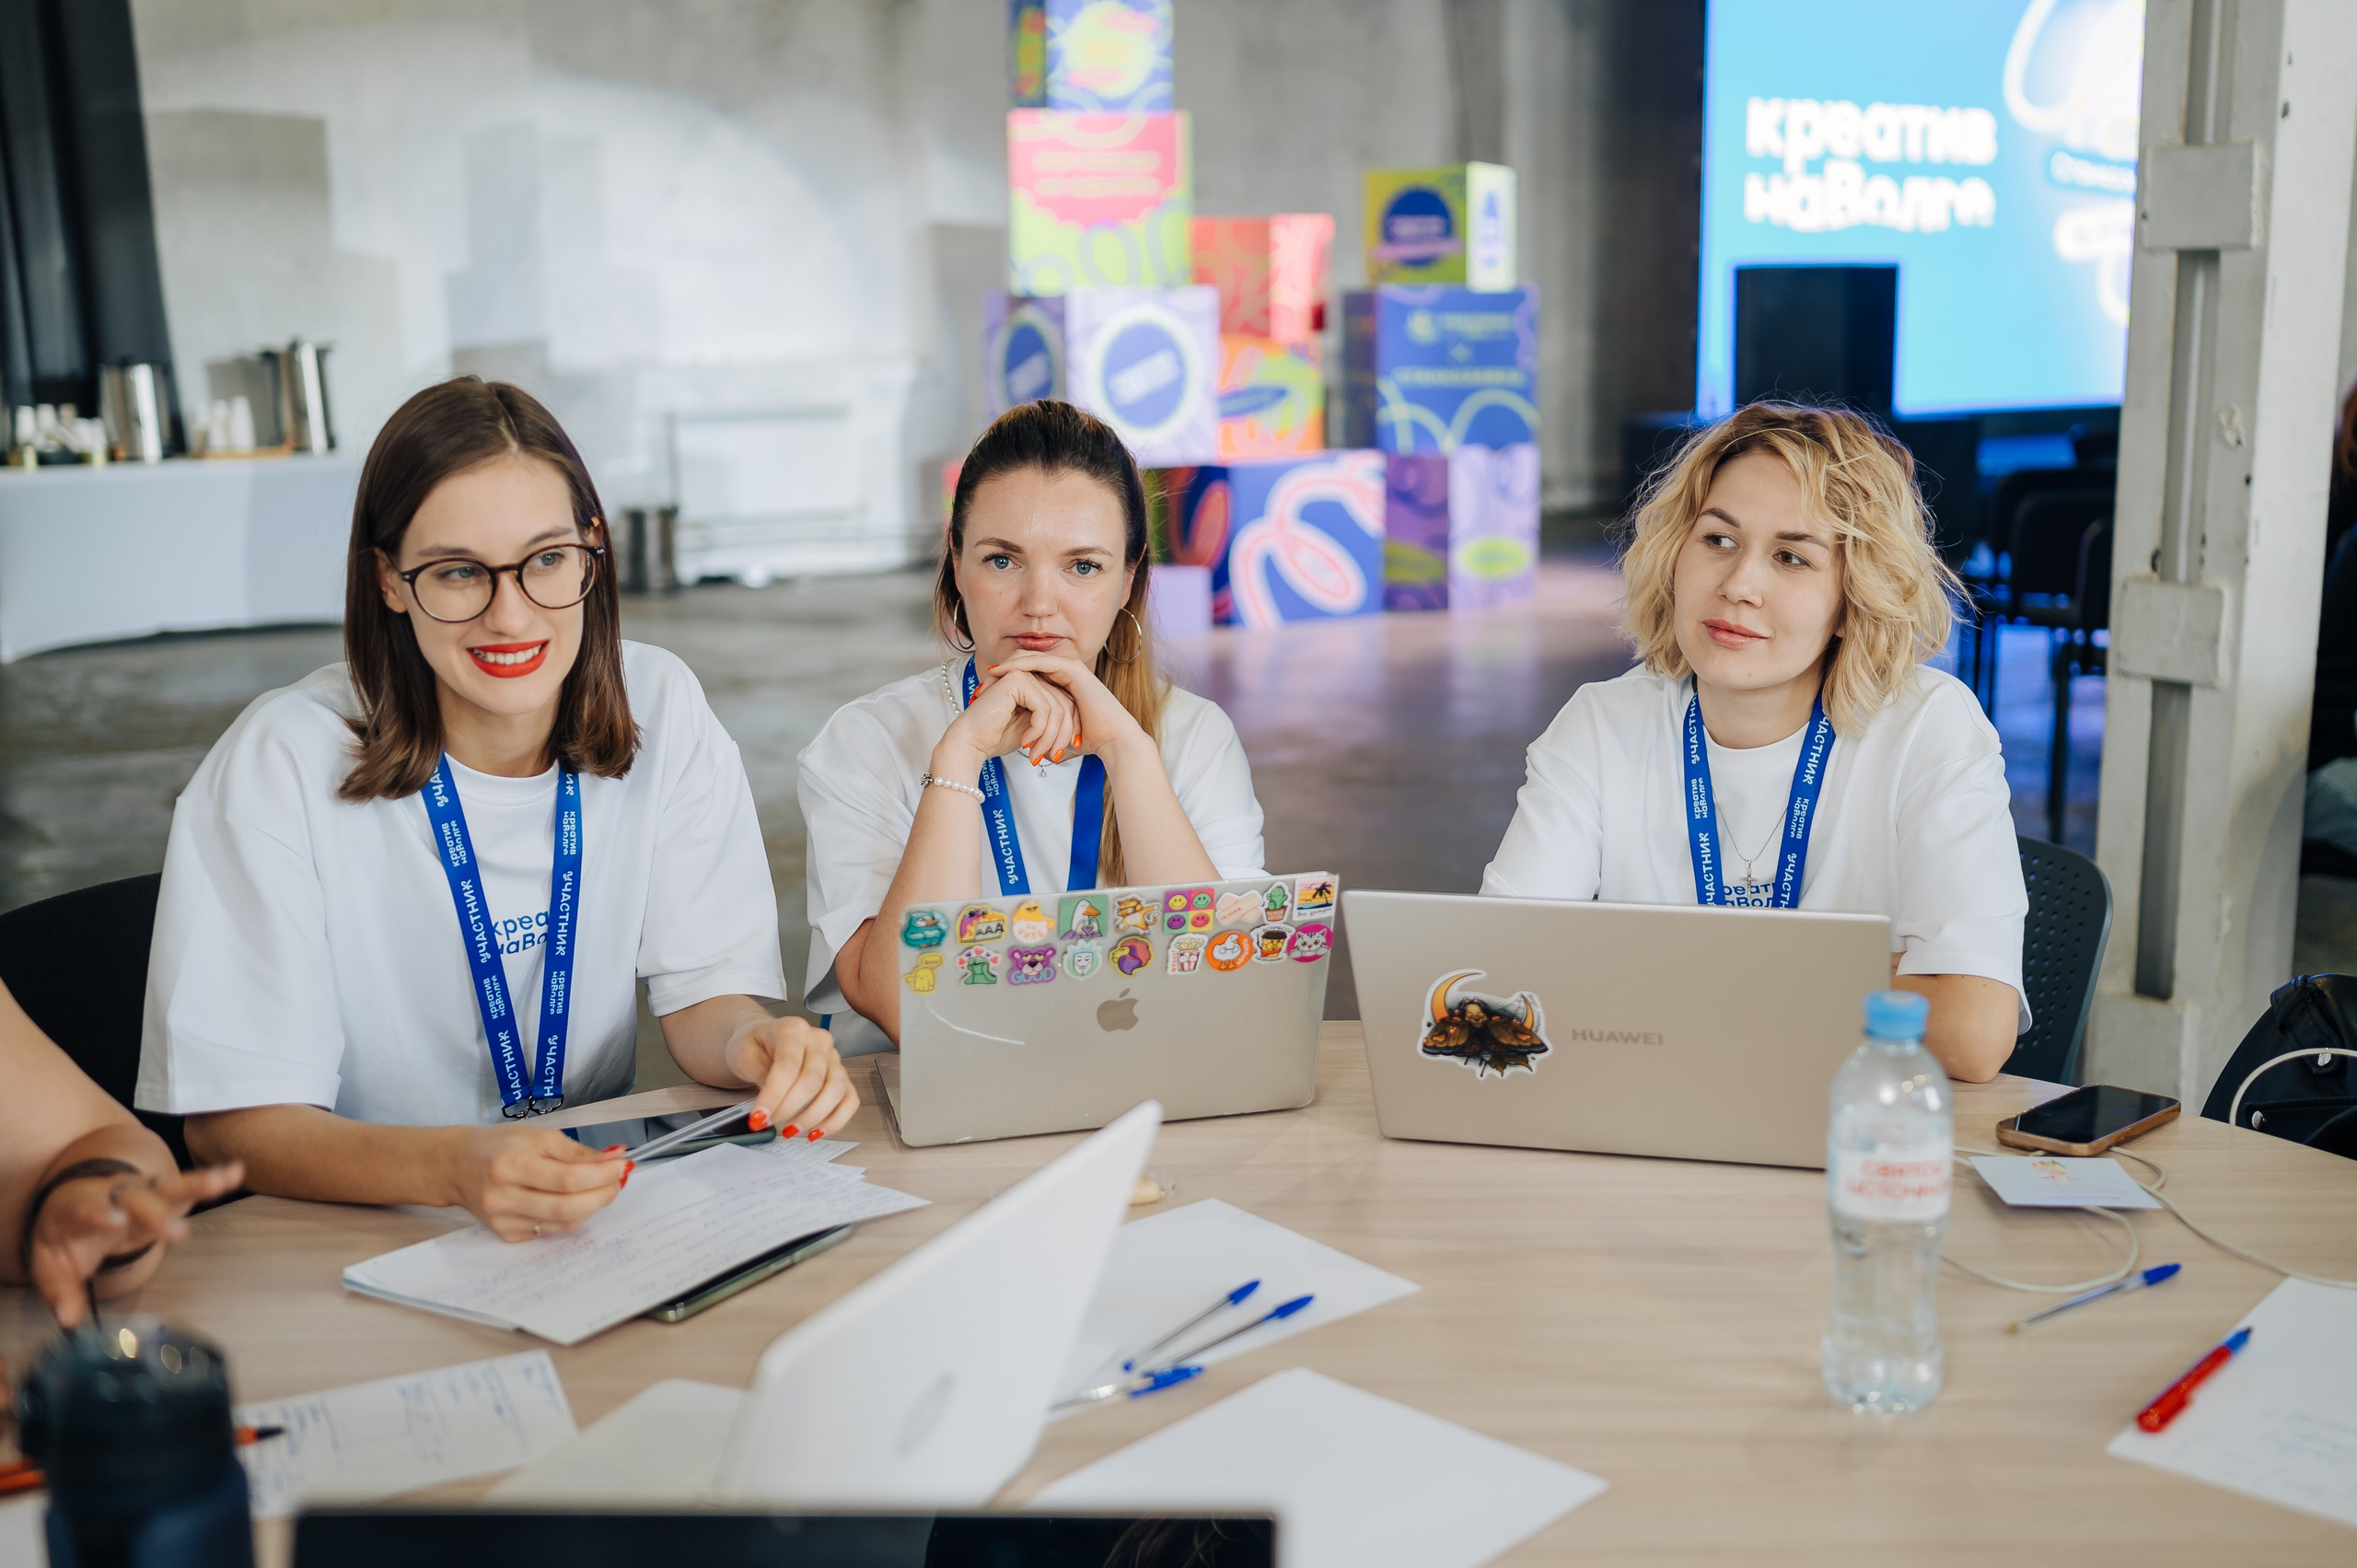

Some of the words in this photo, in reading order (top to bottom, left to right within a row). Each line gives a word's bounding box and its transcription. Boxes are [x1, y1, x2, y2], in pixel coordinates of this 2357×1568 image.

[1746, 97, 1997, 173] креатив
[1802, 710, 1829, 784] ЧАСТНИК
[1691, 778, 1701, 819] креатив
[1796, 797, 1810, 840] креатив
[442, 822, 460, 867] креатив
[568, 810, 576, 855] креатив
[993, 809, 1018, 884] УЧАСТНИК
[1779, 853, 1797, 910] УЧАСТН
[460, 878, 492, 964] УЧАСТНИК
[493, 912, 549, 940] креа
[555, 870, 574, 957] УЧАСТНИК
[482, 977, 498, 1019] креатив
[556, 970, 565, 1015] креатив
[1571, 1028, 1664, 1046] HUAWEI
[498, 1029, 523, 1102] ЧАСТНИК
[543, 1035, 558, 1097] УЧАСТН
